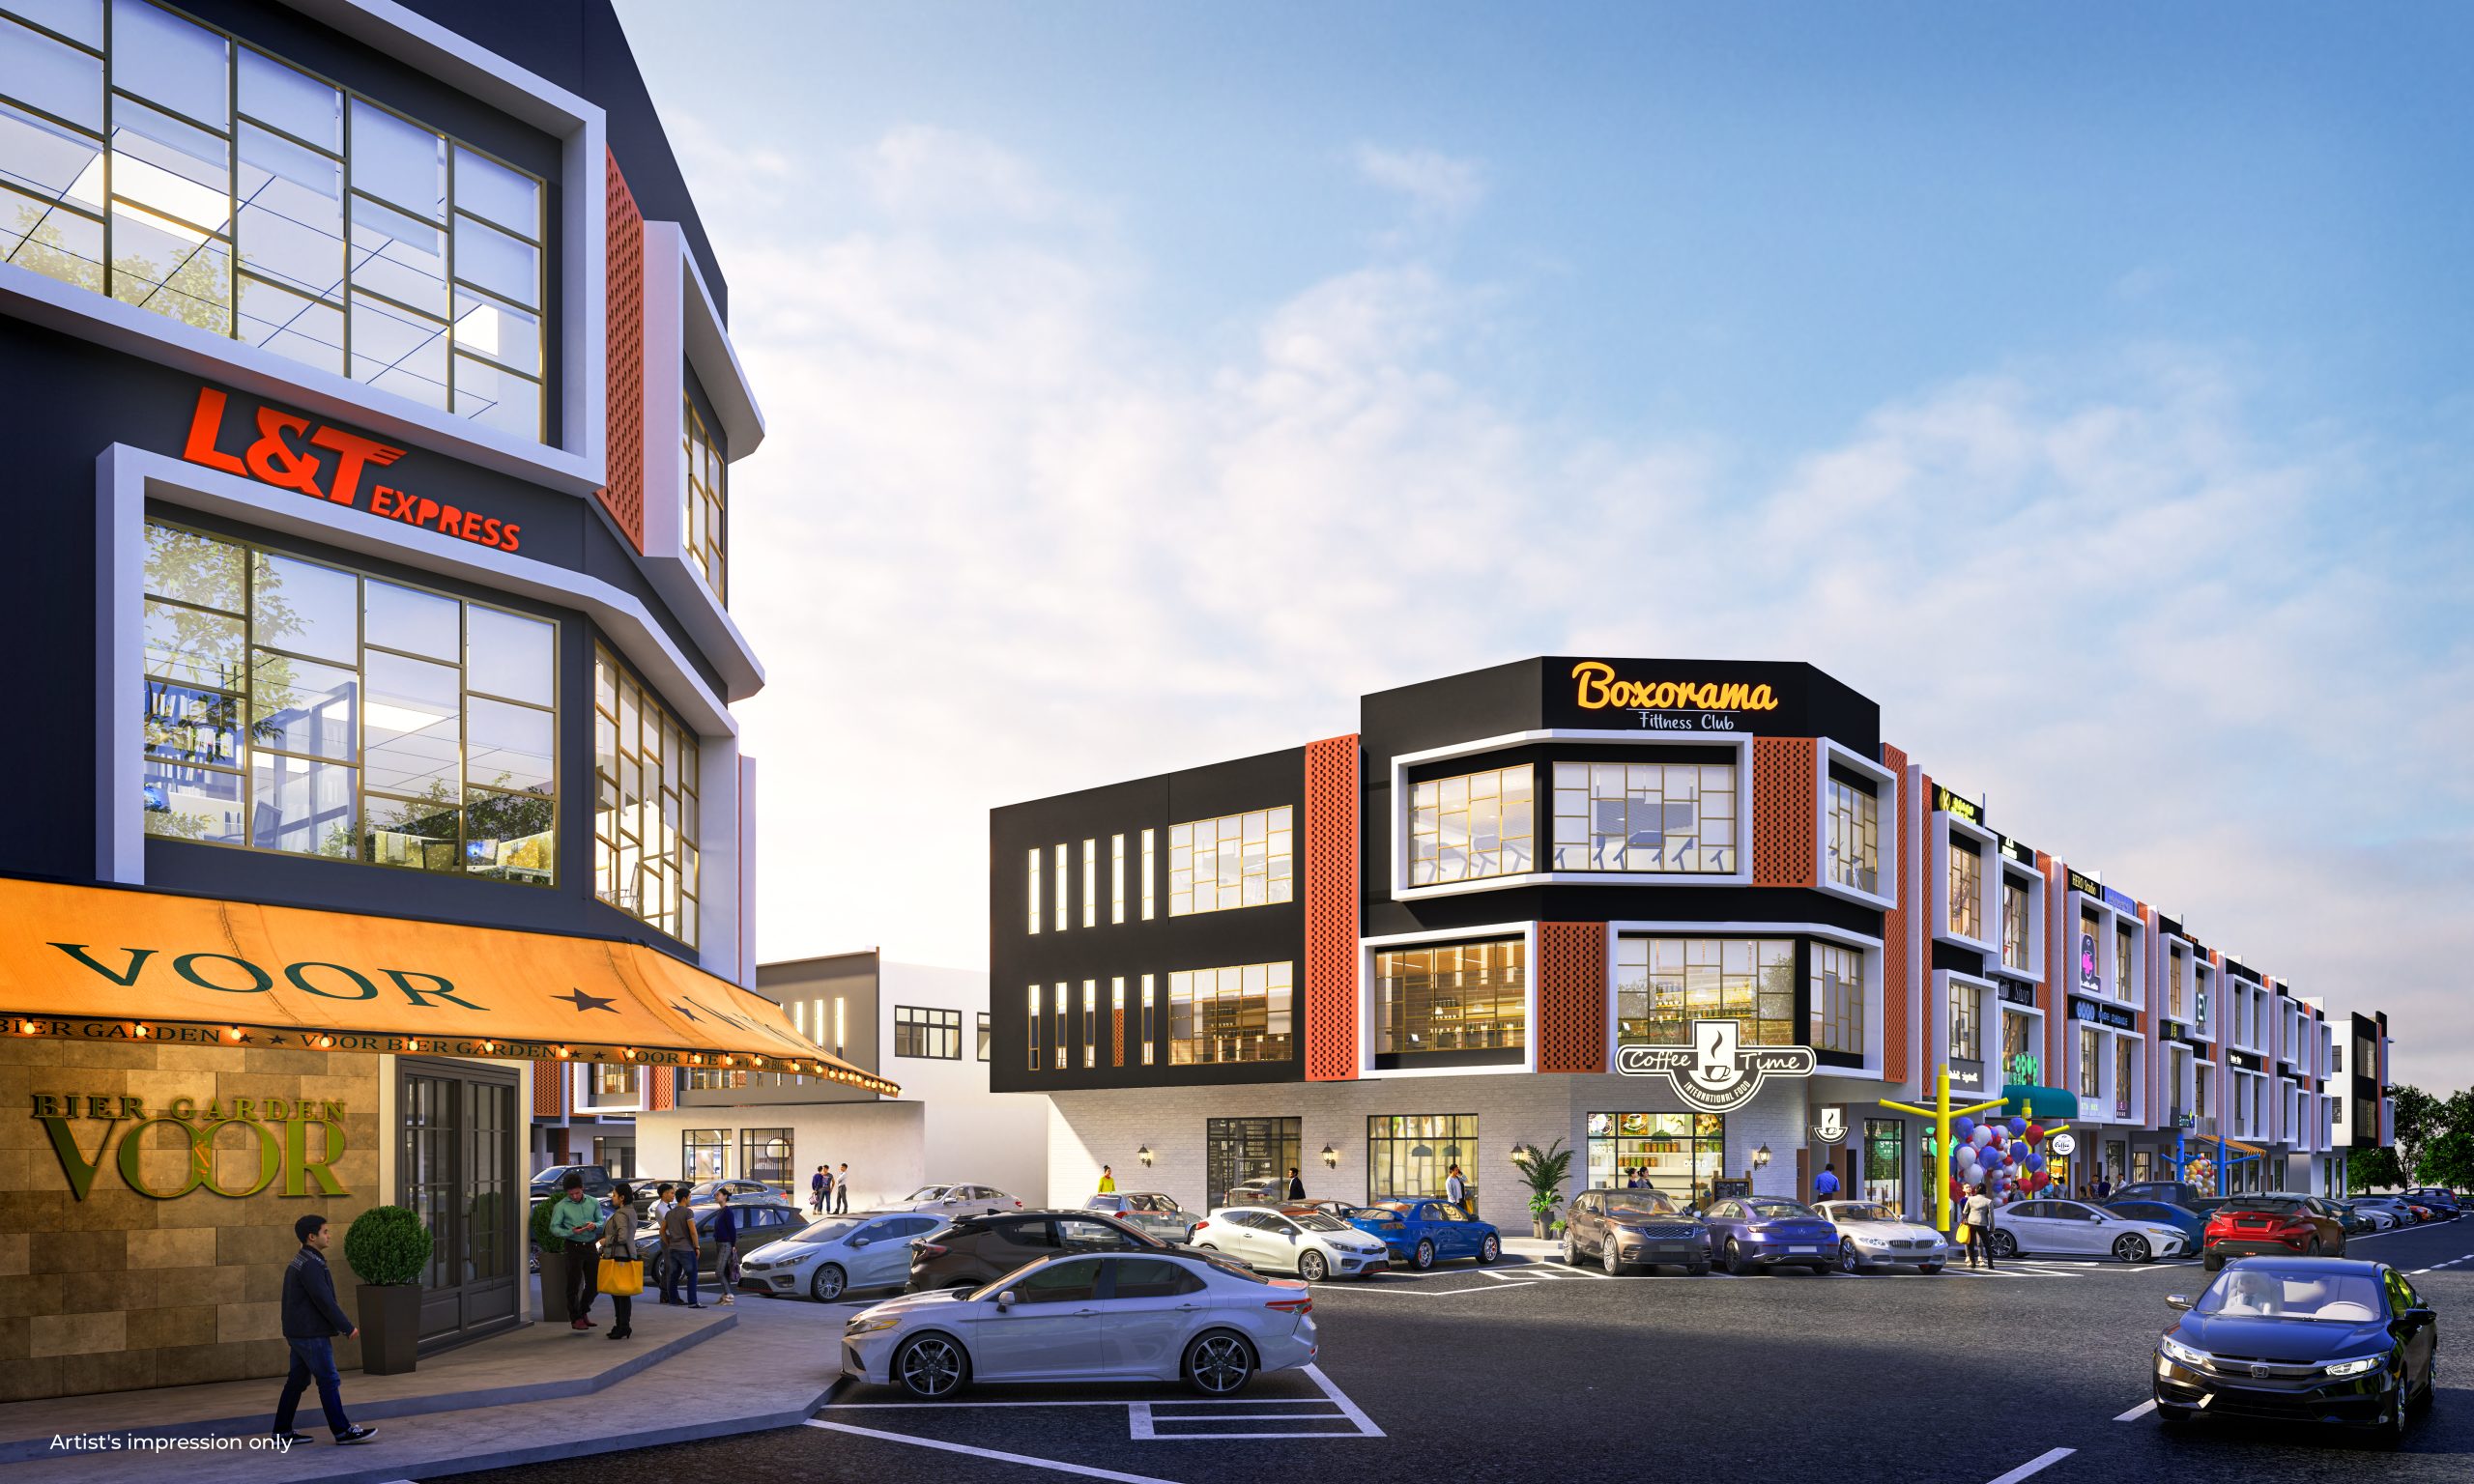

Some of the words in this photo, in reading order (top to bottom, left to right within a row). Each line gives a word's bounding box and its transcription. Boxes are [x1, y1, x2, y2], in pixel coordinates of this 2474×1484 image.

[183, 386, 408, 506] L&T
[370, 484, 522, 553] EXPRESS
[1571, 661, 1779, 711] Boxorama
[1701, 713, 1735, 730] Club
[45, 942, 491, 1011] VOOR
[83, 1024, 220, 1042] GARDEN
[301, 1034, 379, 1049] VOOR
[388, 1039, 447, 1052] BIER
[456, 1042, 558, 1058] GARDEN
[1629, 1050, 1691, 1070] Coffee
[1740, 1051, 1800, 1070] Time
[1683, 1081, 1735, 1103] INTERNATIONAL
[1734, 1080, 1751, 1099] FOOD
[32, 1094, 147, 1119] BIER
[170, 1098, 345, 1121] GARDEN
[37, 1117, 353, 1202] VOOR
